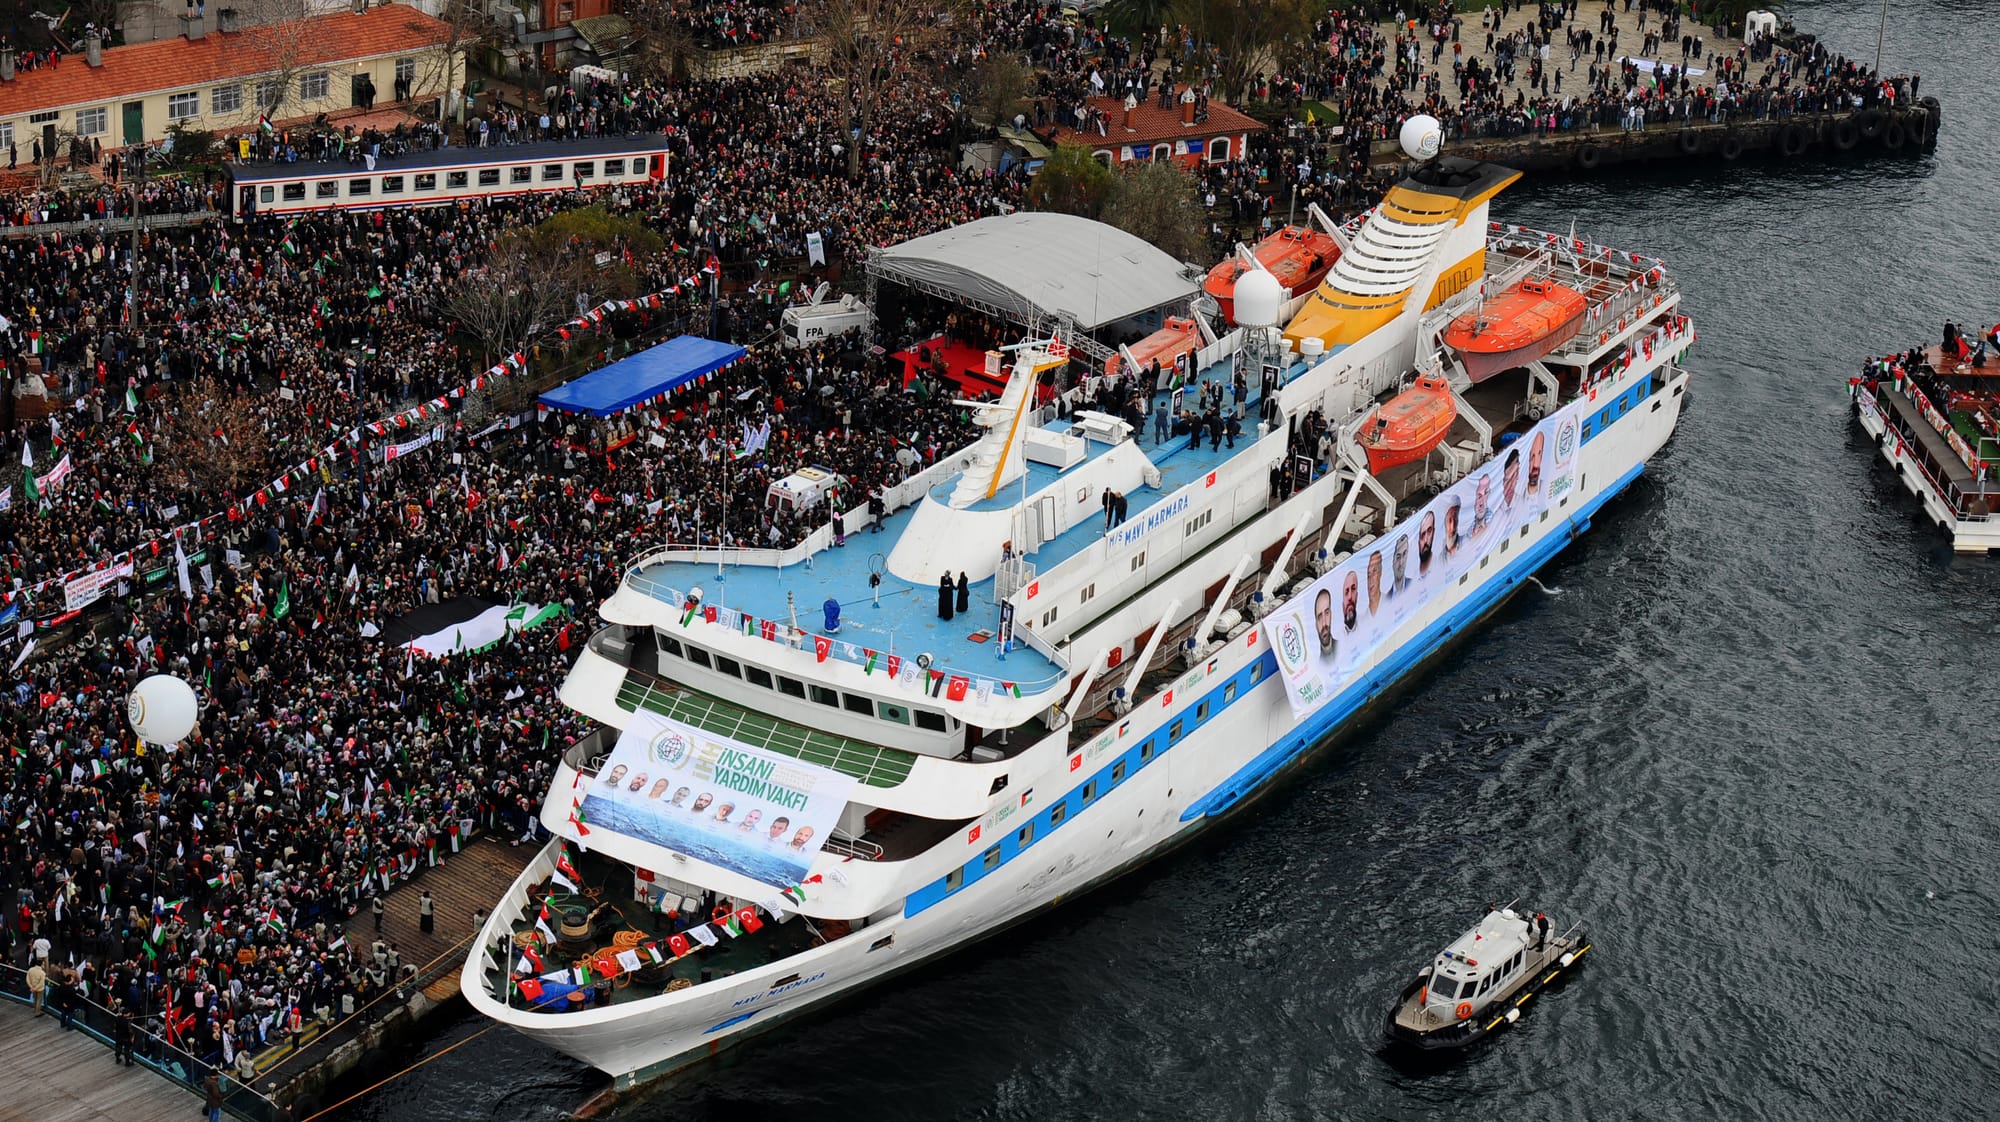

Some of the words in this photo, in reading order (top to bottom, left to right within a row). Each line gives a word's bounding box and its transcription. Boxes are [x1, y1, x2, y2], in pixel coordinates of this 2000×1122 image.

[806, 327, 824, 338] FPA
[1109, 531, 1122, 547] M/S
[1147, 494, 1189, 531] MARMARA
[713, 765, 768, 798] YARDIM
[766, 783, 809, 812] VAKFI
[767, 971, 826, 997] MARMARA
